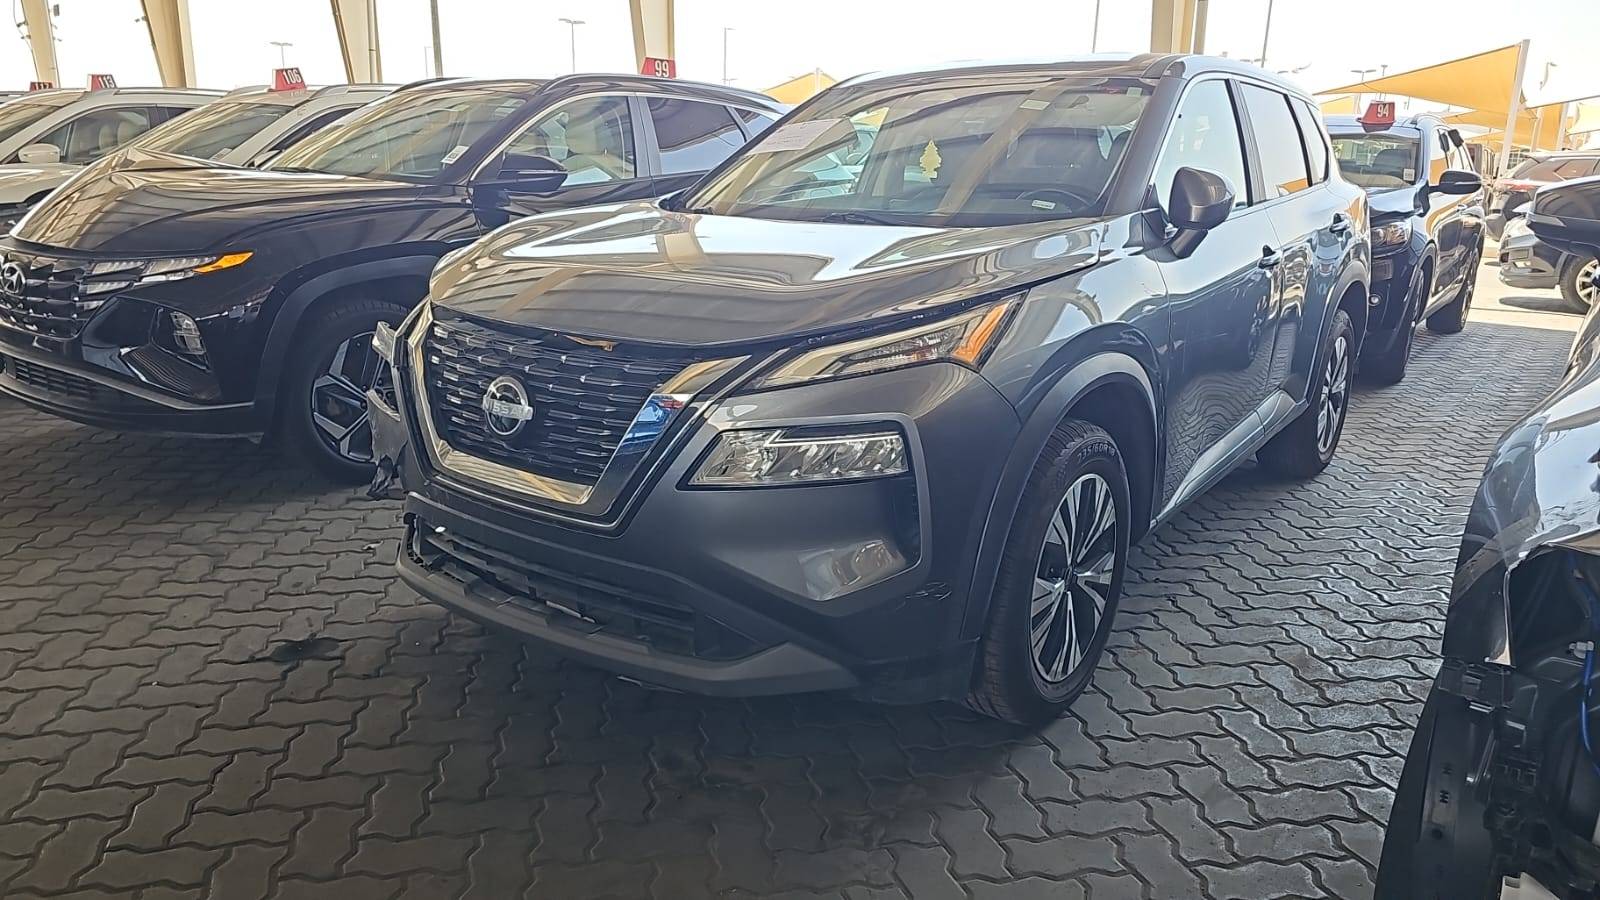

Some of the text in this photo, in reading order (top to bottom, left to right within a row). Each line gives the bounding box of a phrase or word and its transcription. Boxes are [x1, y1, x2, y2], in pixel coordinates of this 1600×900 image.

[655, 60, 669, 77] 99
[98, 75, 114, 88] 113
[282, 69, 302, 84] 106
[1377, 104, 1389, 117] 94
